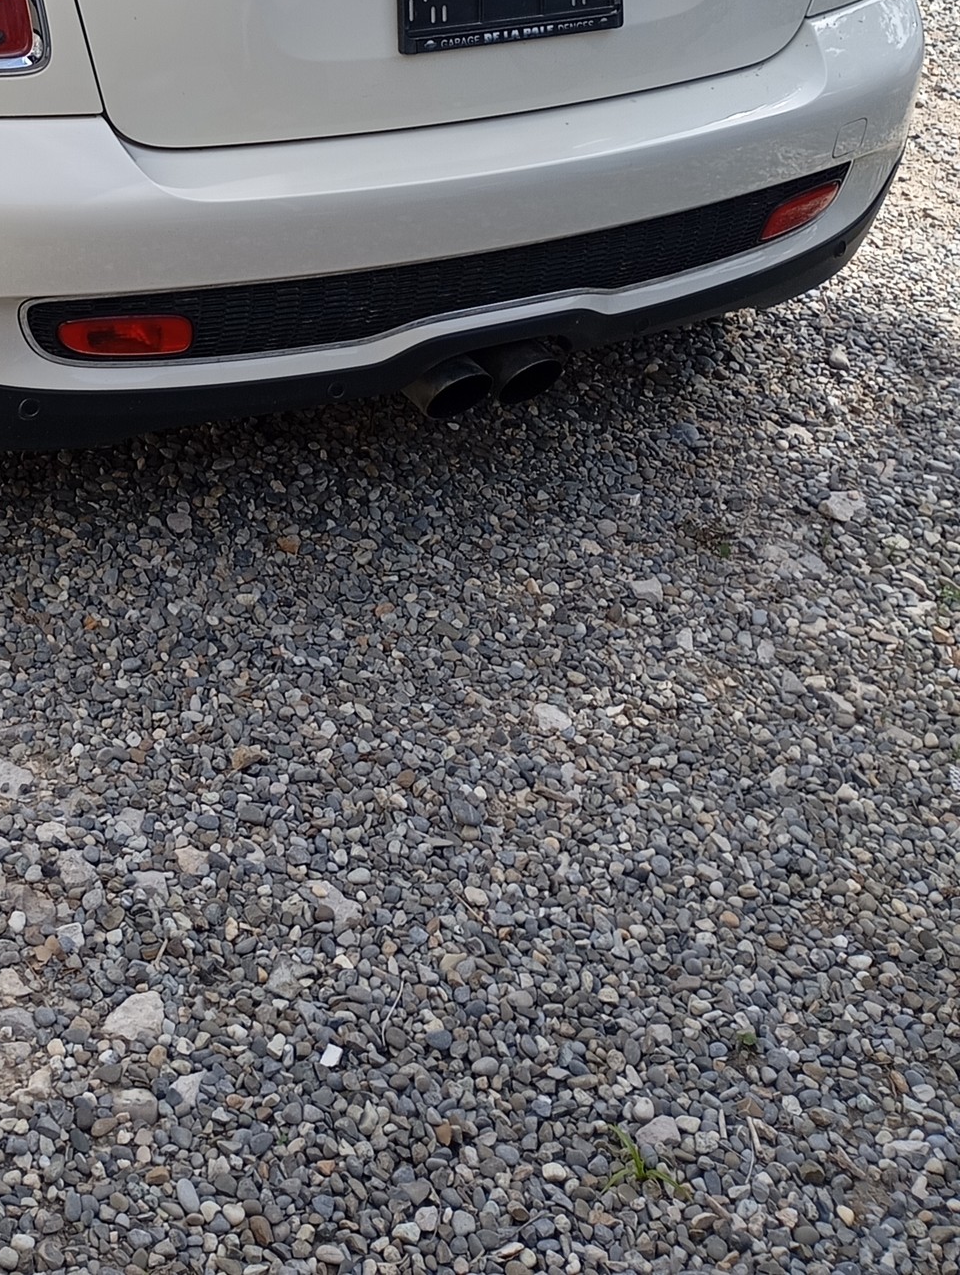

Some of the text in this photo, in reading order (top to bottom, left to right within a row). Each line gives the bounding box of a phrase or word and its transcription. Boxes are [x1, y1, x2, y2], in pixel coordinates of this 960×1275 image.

[441, 35, 480, 48] GARAGE
[484, 32, 500, 43] DE
[504, 28, 520, 40] LA
